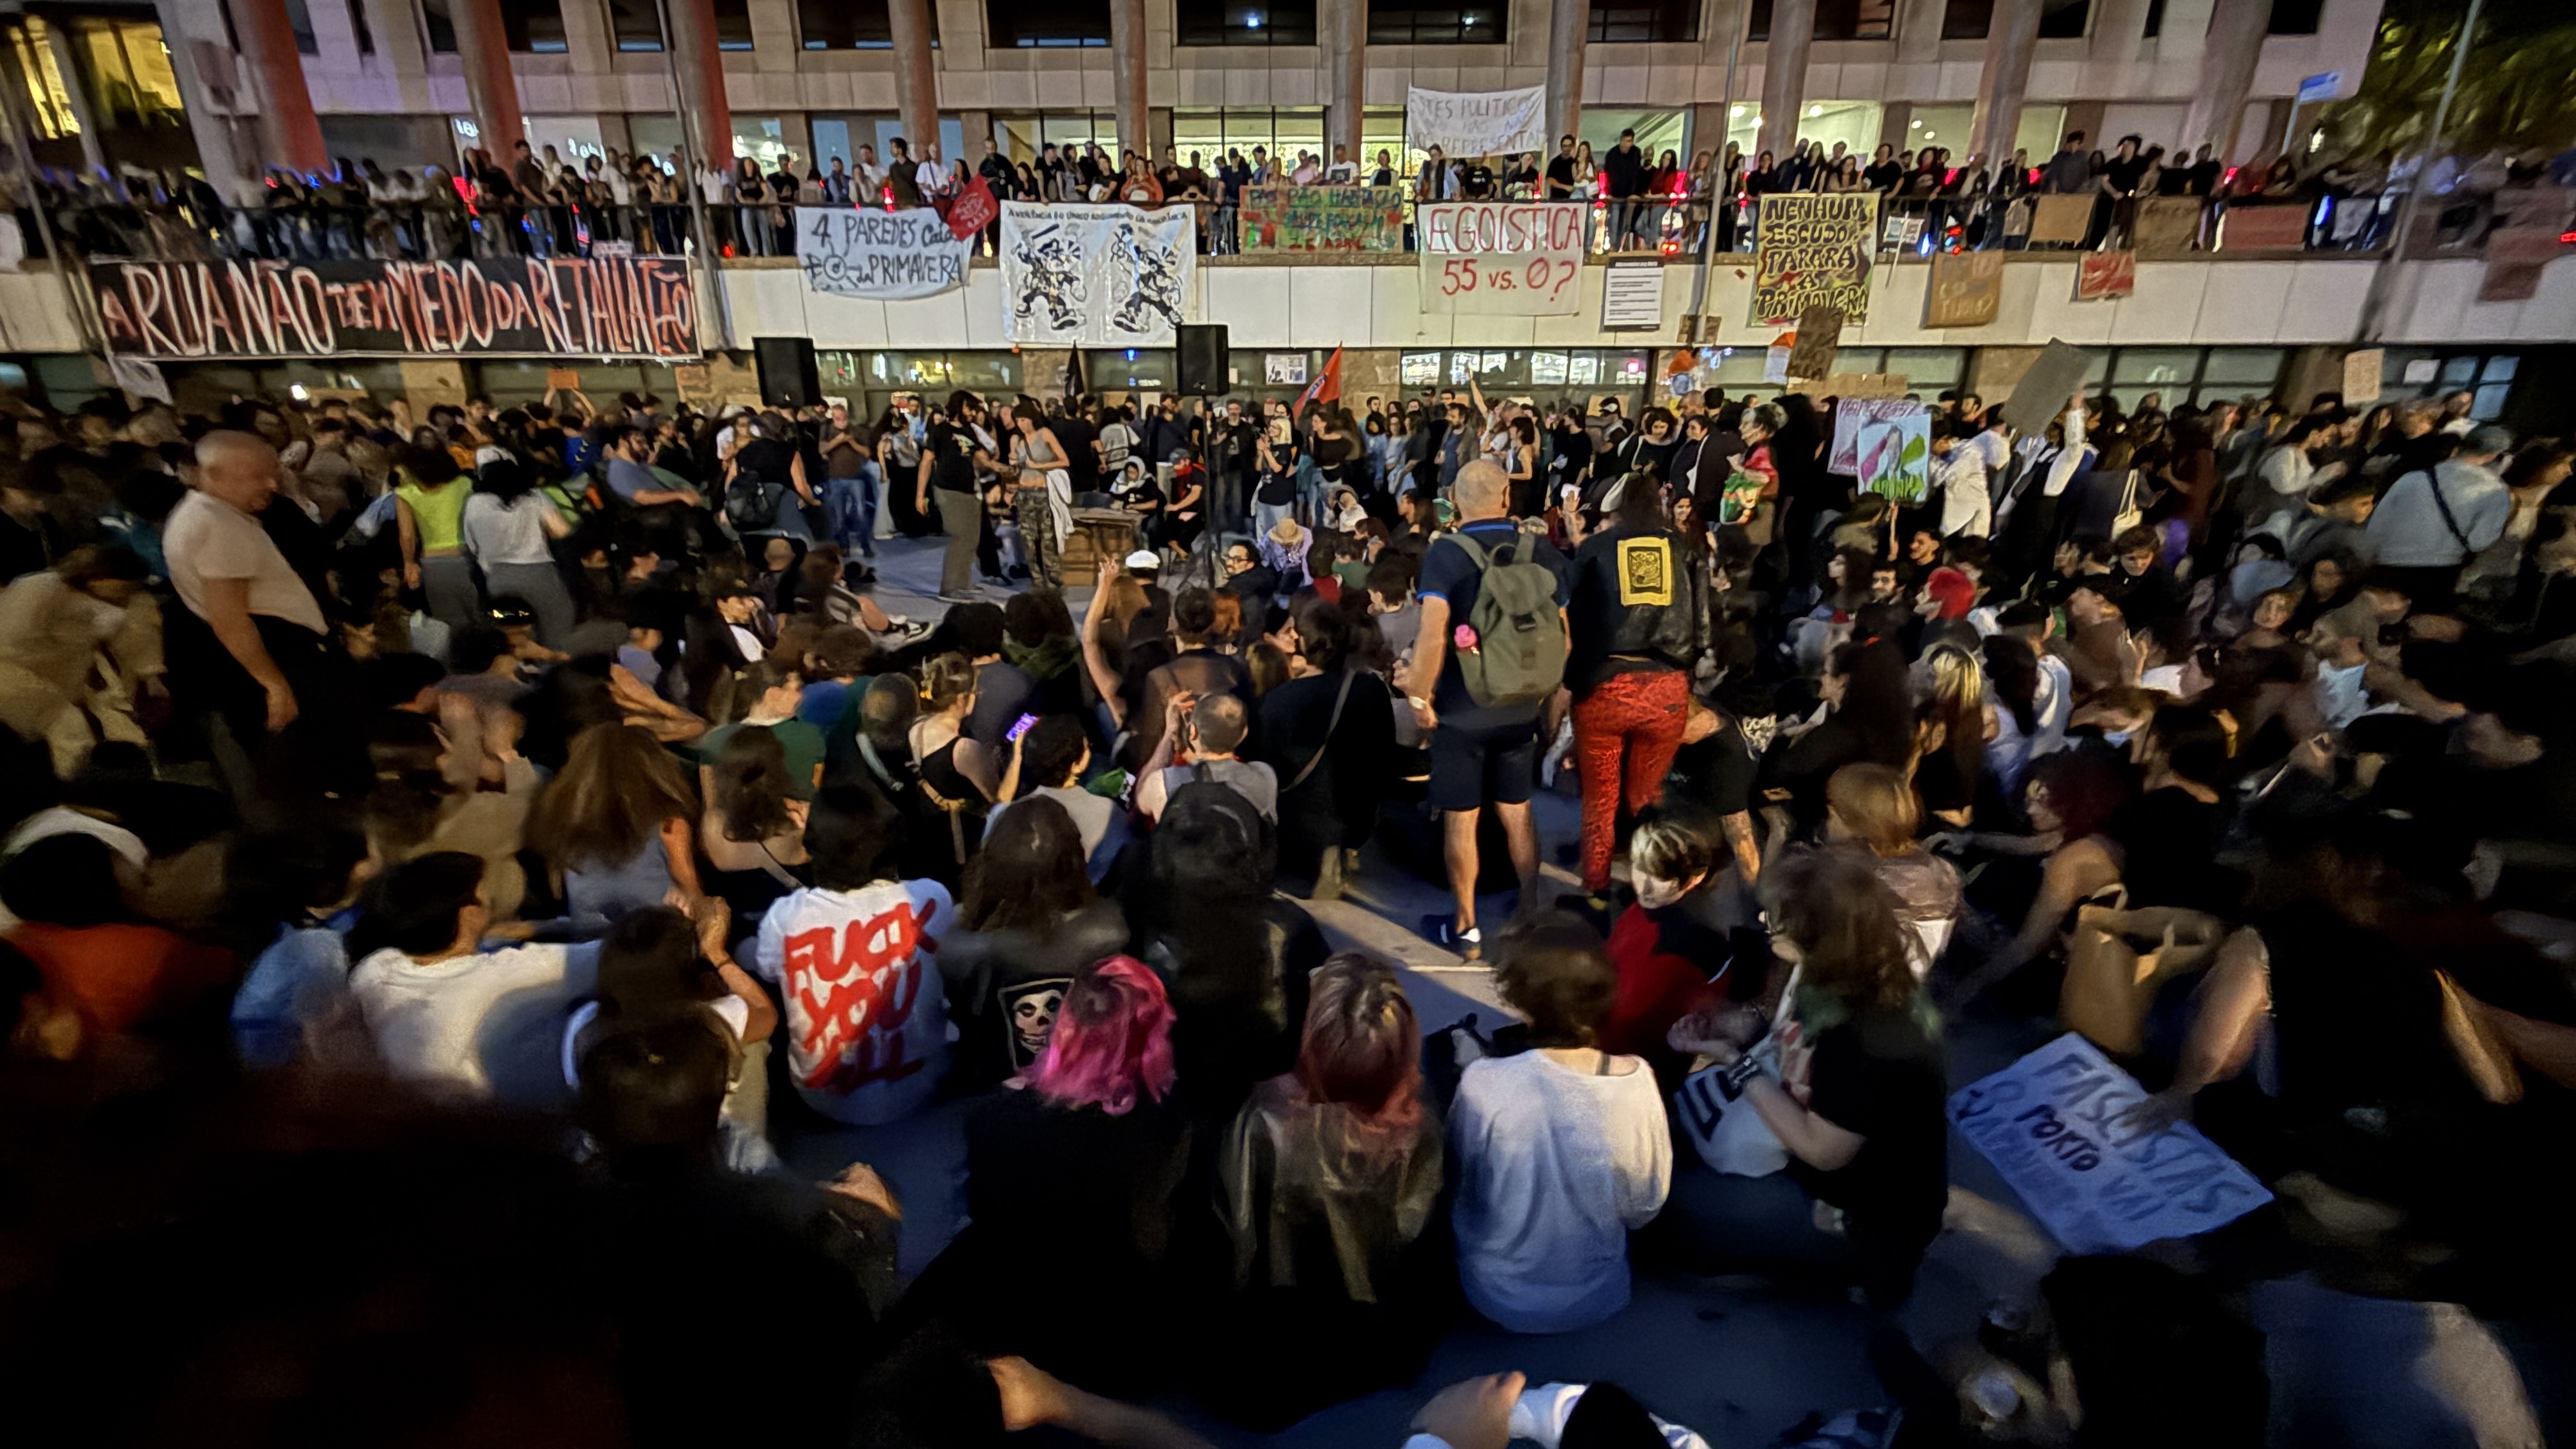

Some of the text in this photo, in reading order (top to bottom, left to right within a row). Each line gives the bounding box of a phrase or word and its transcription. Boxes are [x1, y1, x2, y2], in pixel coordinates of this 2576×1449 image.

[1765, 197, 1867, 222] NENHUM
[812, 213, 831, 247] 4
[843, 215, 918, 249] PAREDES
[1765, 223, 1850, 246] ESCUDO
[867, 252, 963, 285] PRIMAVERA
[1441, 258, 1478, 296] 55
[1488, 270, 1517, 290] vs.
[1798, 272, 1821, 291] A
[102, 286, 137, 339] A
[120, 262, 241, 356] RUA
[226, 257, 334, 356] NÃO
[326, 280, 400, 332] TEM
[385, 258, 493, 353] MEDO
[490, 280, 539, 330] DA
[785, 898, 937, 999] FUCK
[801, 962, 921, 1054] YOU
[2014, 1103, 2101, 1172] PORTO
